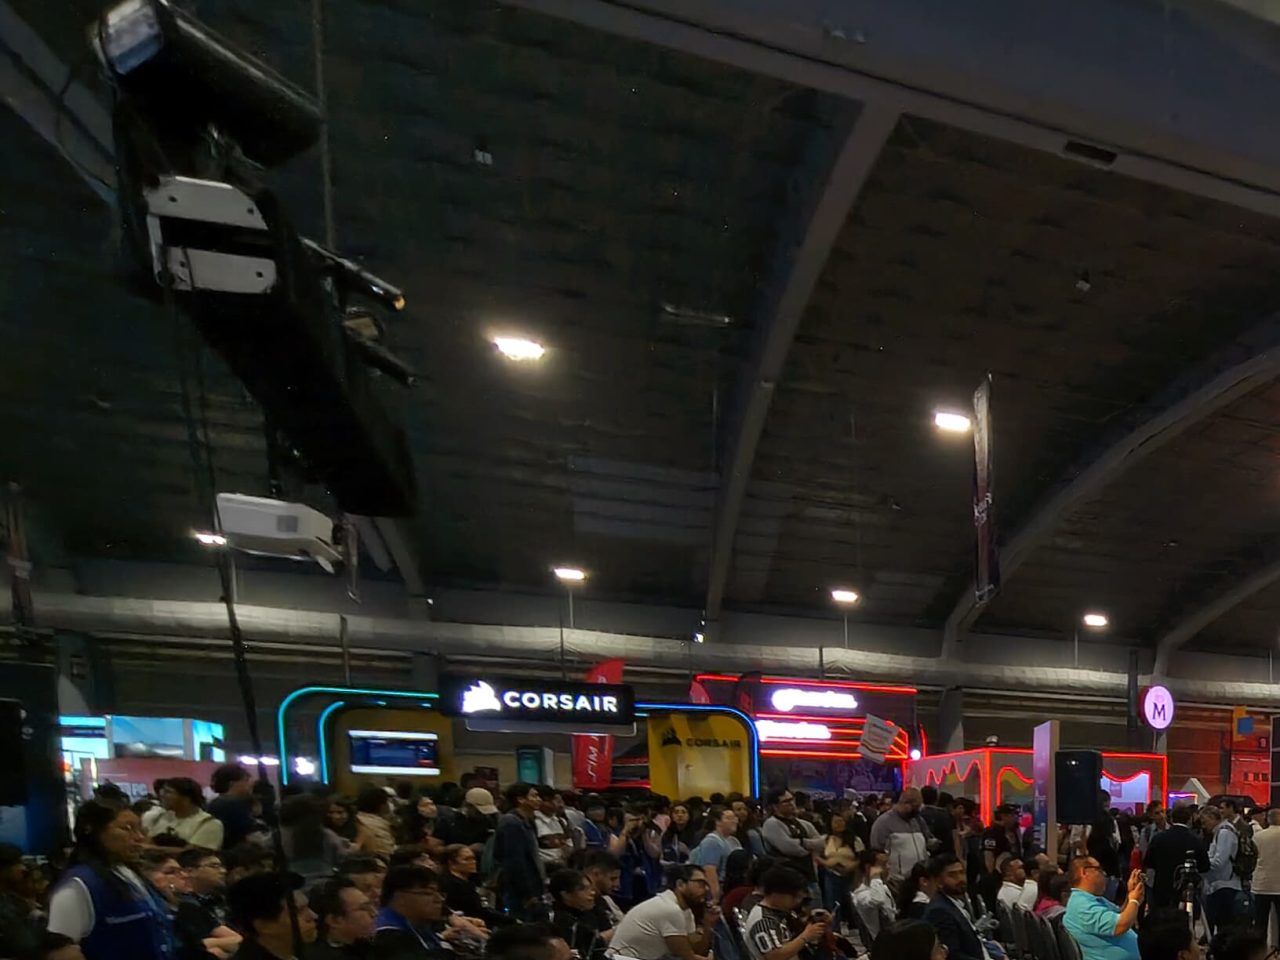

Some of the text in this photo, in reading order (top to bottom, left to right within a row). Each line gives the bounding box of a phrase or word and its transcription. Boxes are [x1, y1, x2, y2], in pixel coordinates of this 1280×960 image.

[503, 691, 618, 713] CORSAIR
[1152, 702, 1166, 721] M
[686, 737, 742, 749] CORSAIR
